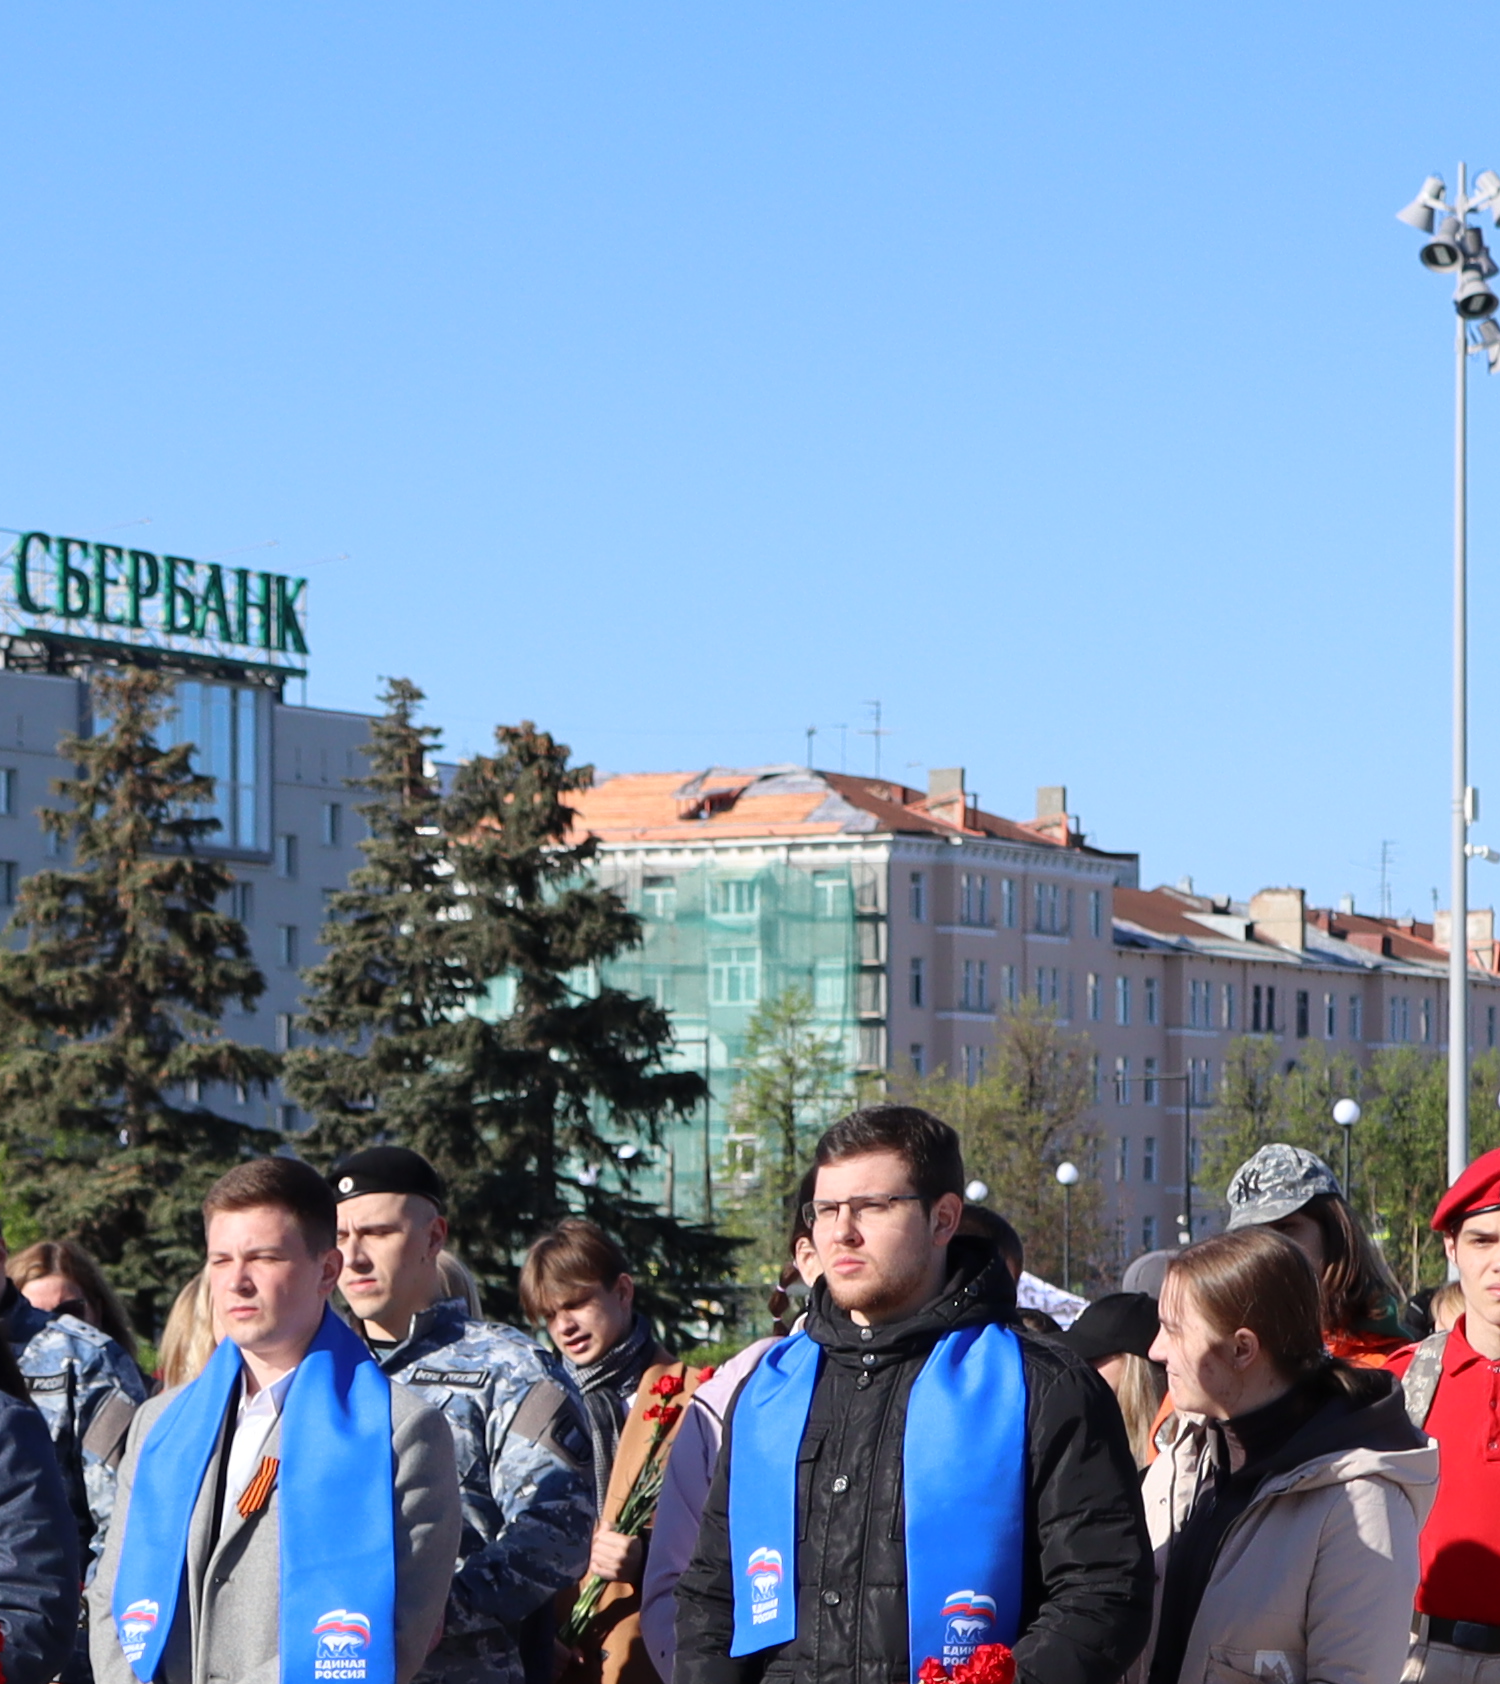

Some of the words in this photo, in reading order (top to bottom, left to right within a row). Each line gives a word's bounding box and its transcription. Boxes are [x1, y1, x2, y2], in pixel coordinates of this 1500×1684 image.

[14, 532, 309, 655] СБЕРБАНК
[314, 1659, 366, 1670] ЕДИНАЯ
[314, 1669, 366, 1680] РОССИЯ
